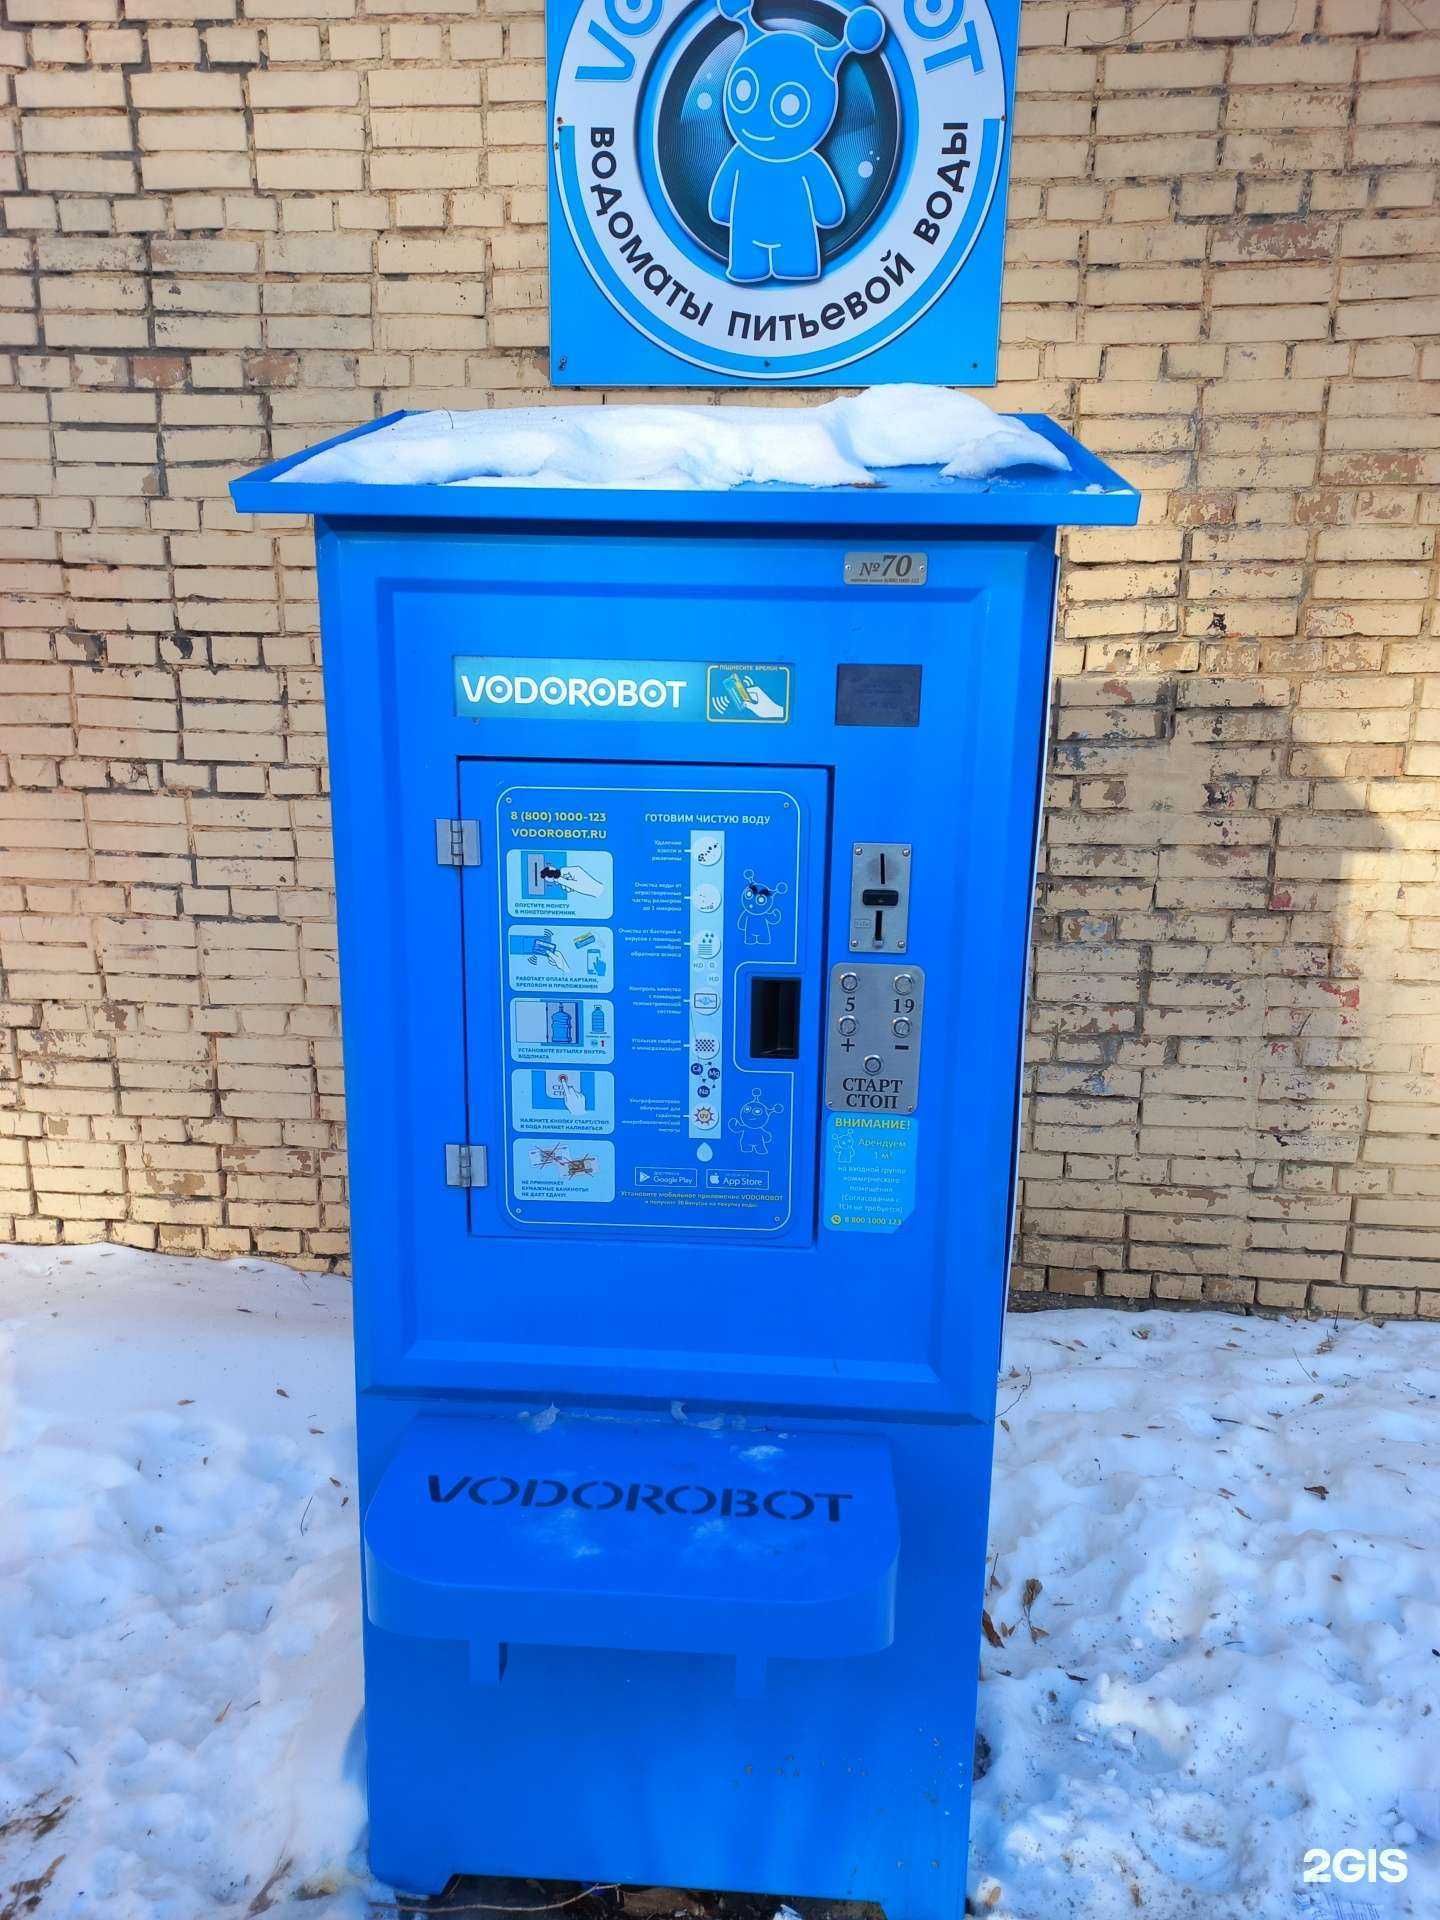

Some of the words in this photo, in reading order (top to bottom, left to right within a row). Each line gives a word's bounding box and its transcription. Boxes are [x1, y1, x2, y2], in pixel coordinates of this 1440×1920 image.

[461, 674, 687, 708] VODOROBOT
[510, 811, 518, 820] 8
[521, 811, 552, 822] (800)
[554, 812, 606, 822] 1000-123
[645, 813, 694, 823] ГОТОВИМ
[696, 814, 739, 824] ЧИСТУЮ
[742, 815, 771, 824] ВОДУ
[511, 828, 607, 839] VODOROBOT.RU
[844, 997, 855, 1012] 5
[893, 998, 915, 1014] 19
[842, 1077, 903, 1093] СТАРТ
[846, 1093, 899, 1109] СТОП
[835, 1117, 910, 1130] ВНИМАНИЕ!
[858, 1138, 906, 1149] Арендуем
[653, 1176, 678, 1184] Google
[679, 1176, 693, 1185] Play
[723, 1177, 740, 1186] App
[742, 1178, 763, 1186] Store
[428, 1474, 854, 1522] VODOROBOT
